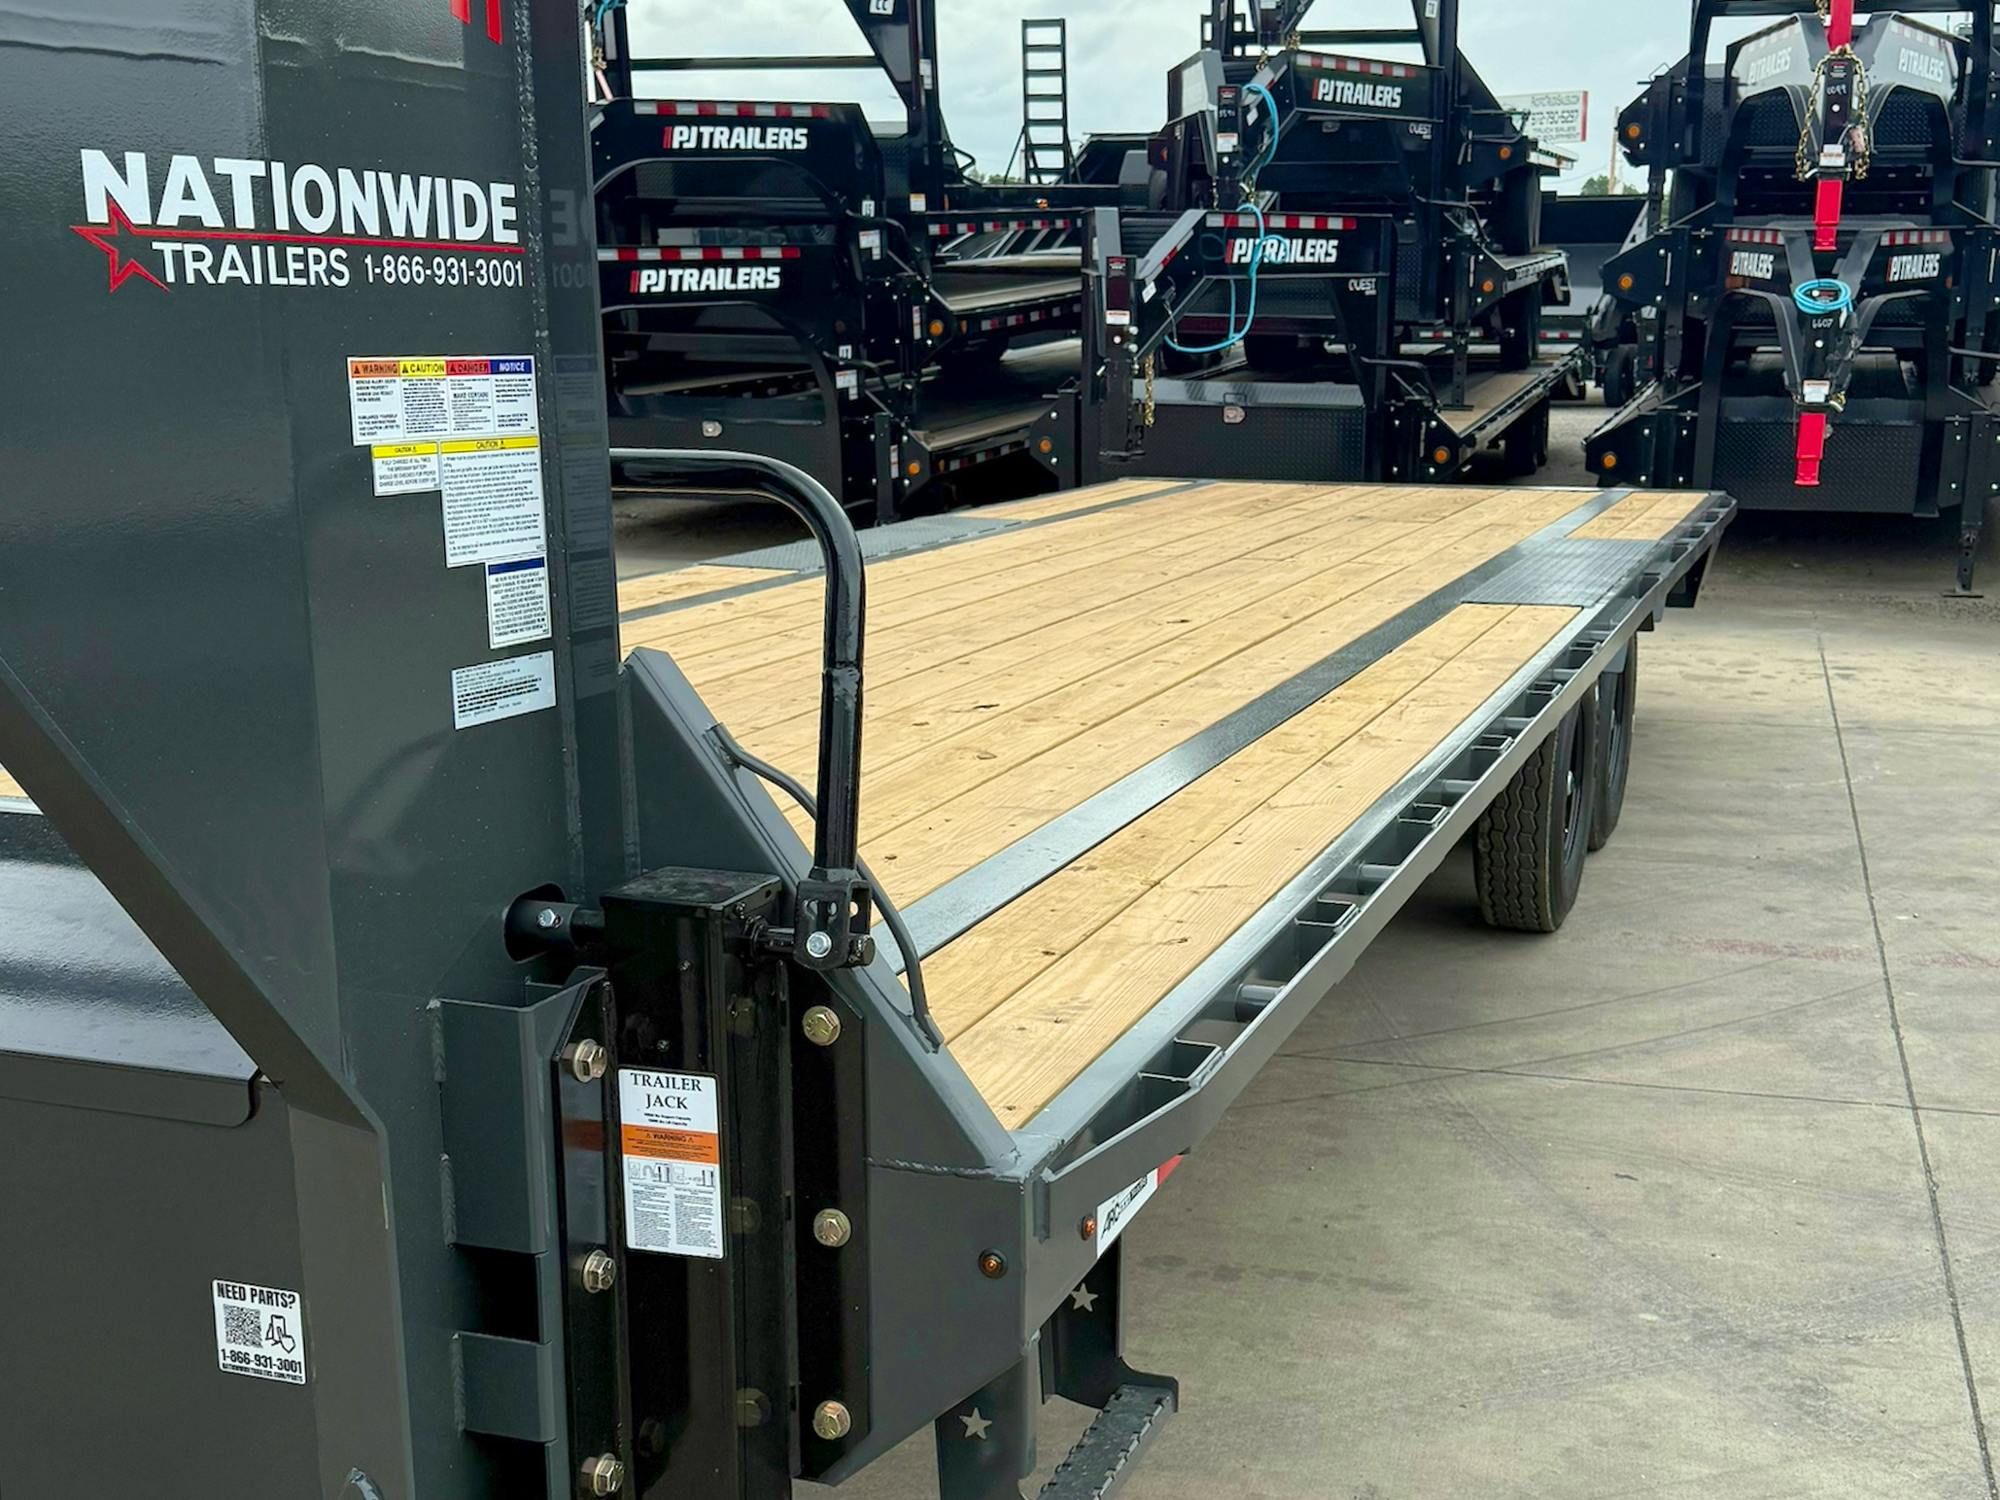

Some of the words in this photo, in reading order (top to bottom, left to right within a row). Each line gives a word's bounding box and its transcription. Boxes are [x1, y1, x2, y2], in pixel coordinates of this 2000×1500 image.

[699, 125, 809, 150] TRAILERS
[81, 148, 519, 245] NATIONWIDE
[152, 241, 349, 287] TRAILERS
[364, 253, 524, 288] 1-866-931-3001
[667, 266, 781, 293] TRAILERS
[362, 361, 398, 374] WARNING
[410, 361, 445, 373] CAUTION
[458, 361, 489, 373] DANGER
[499, 361, 526, 372] NOTICE
[475, 441, 498, 450] CAUTION
[630, 1072, 703, 1092] TRAILER
[645, 1093, 689, 1110] JACK
[653, 1132, 687, 1143] WARNING
[217, 1282, 247, 1301] NEED
[250, 1287, 296, 1309] PARTS?
[221, 1348, 302, 1375] 1-866-931-3001
